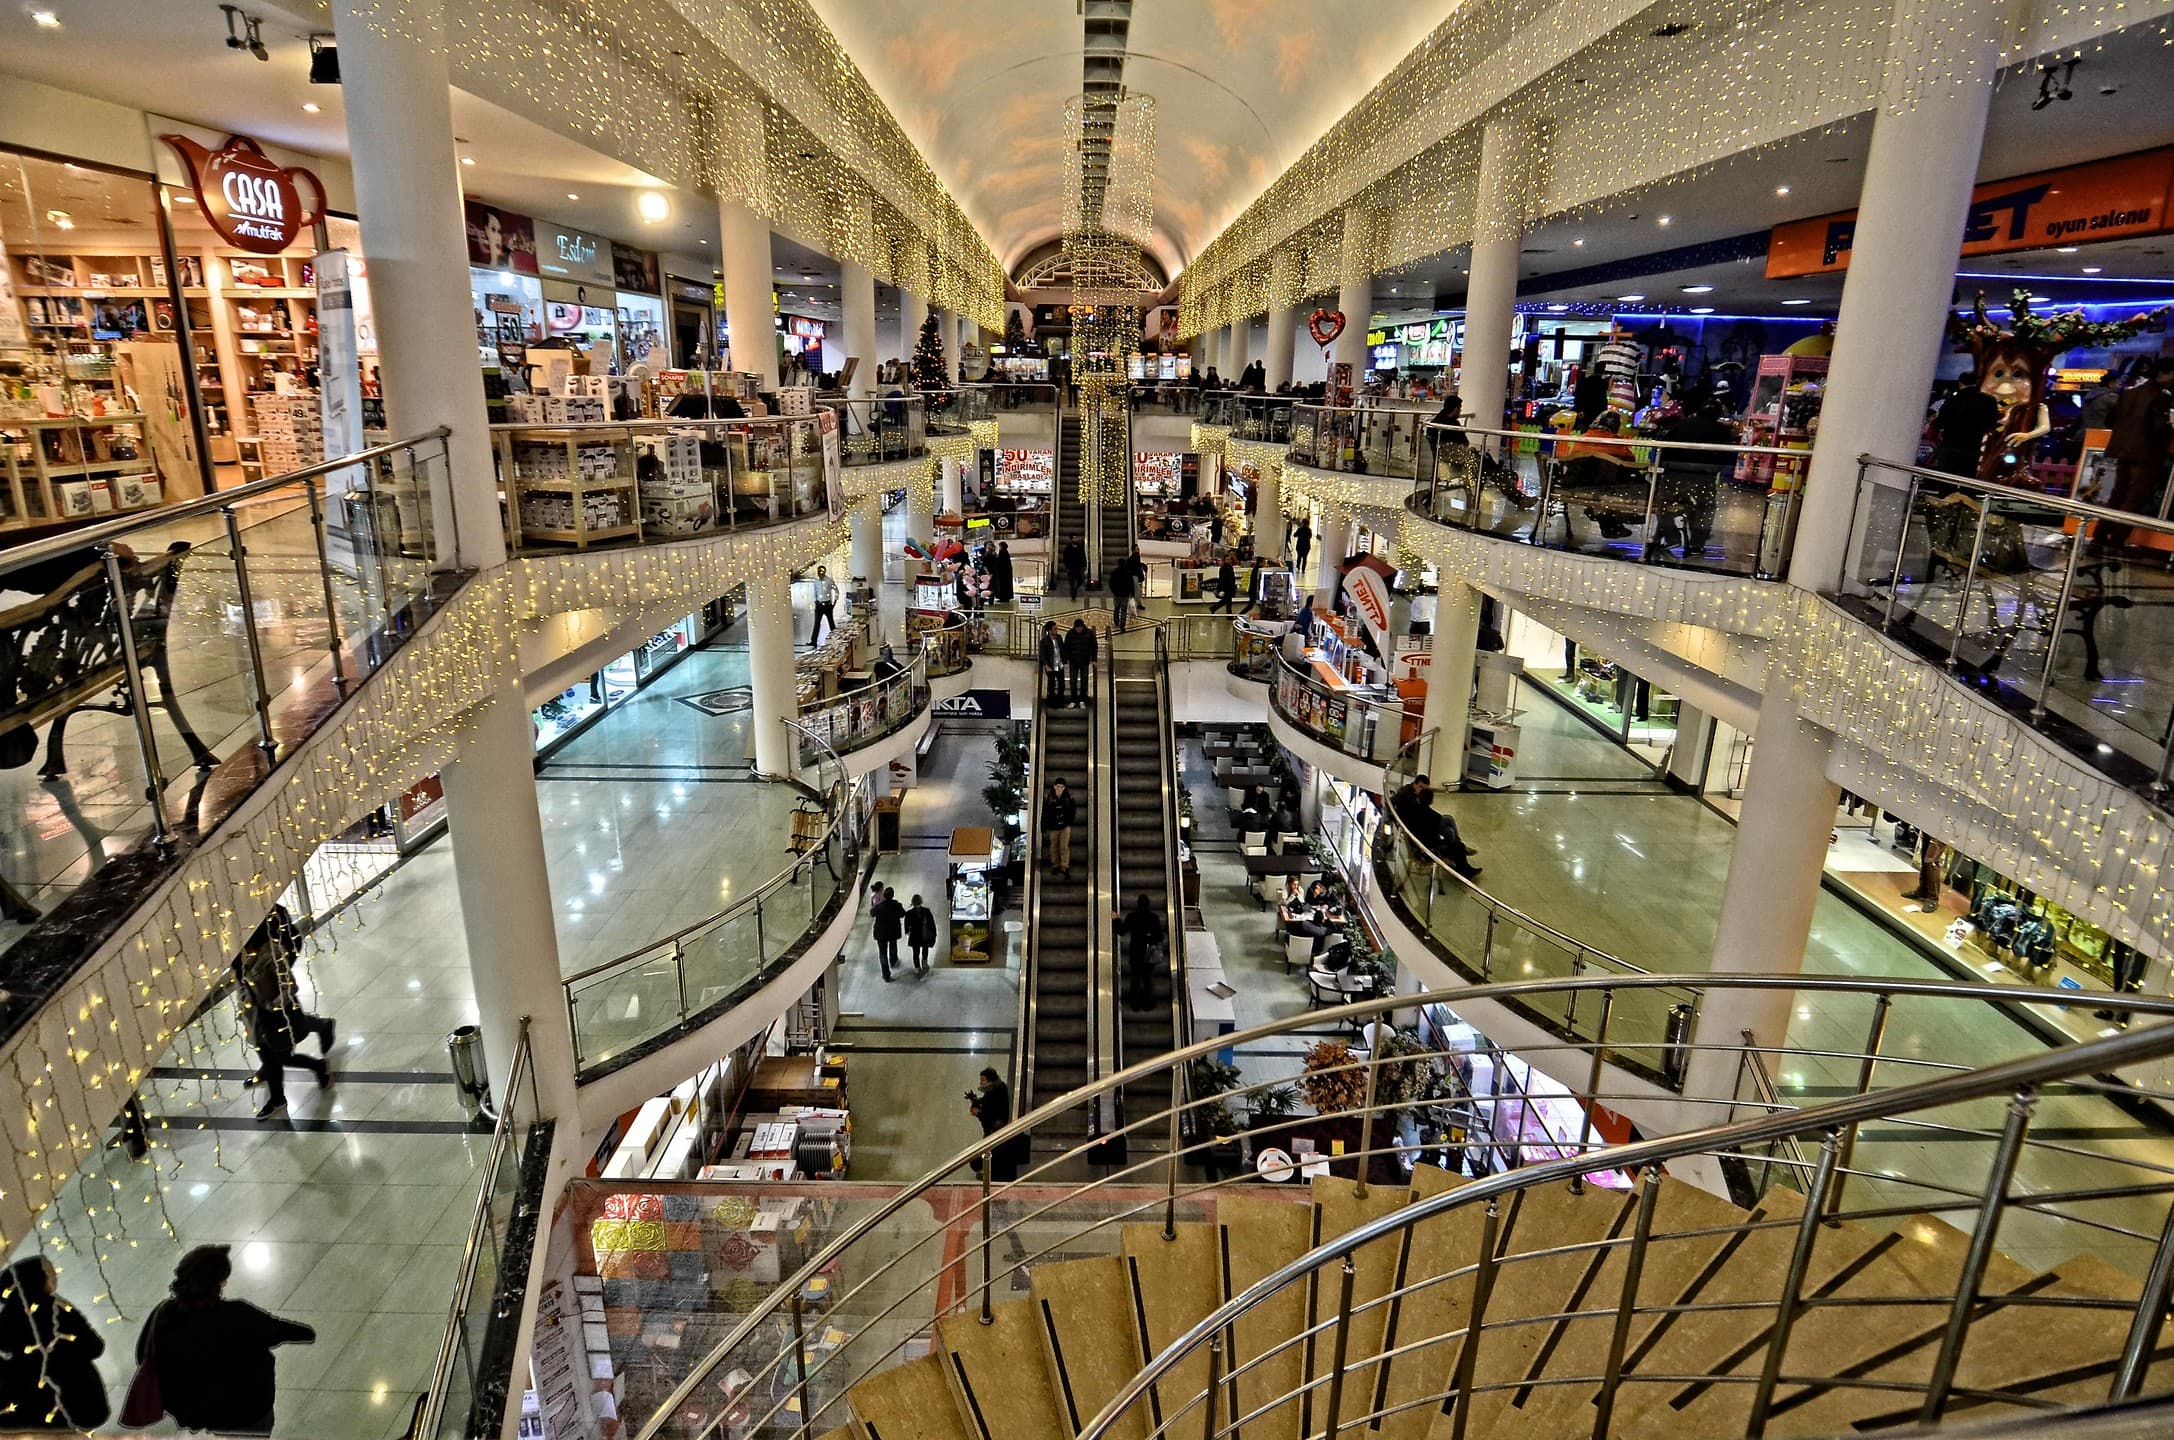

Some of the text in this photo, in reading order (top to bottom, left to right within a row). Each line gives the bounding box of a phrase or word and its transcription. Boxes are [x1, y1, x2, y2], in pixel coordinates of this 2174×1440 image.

[222, 171, 285, 220] CASA
[2046, 207, 2151, 240] oyun salonu
[502, 316, 520, 341] 50
